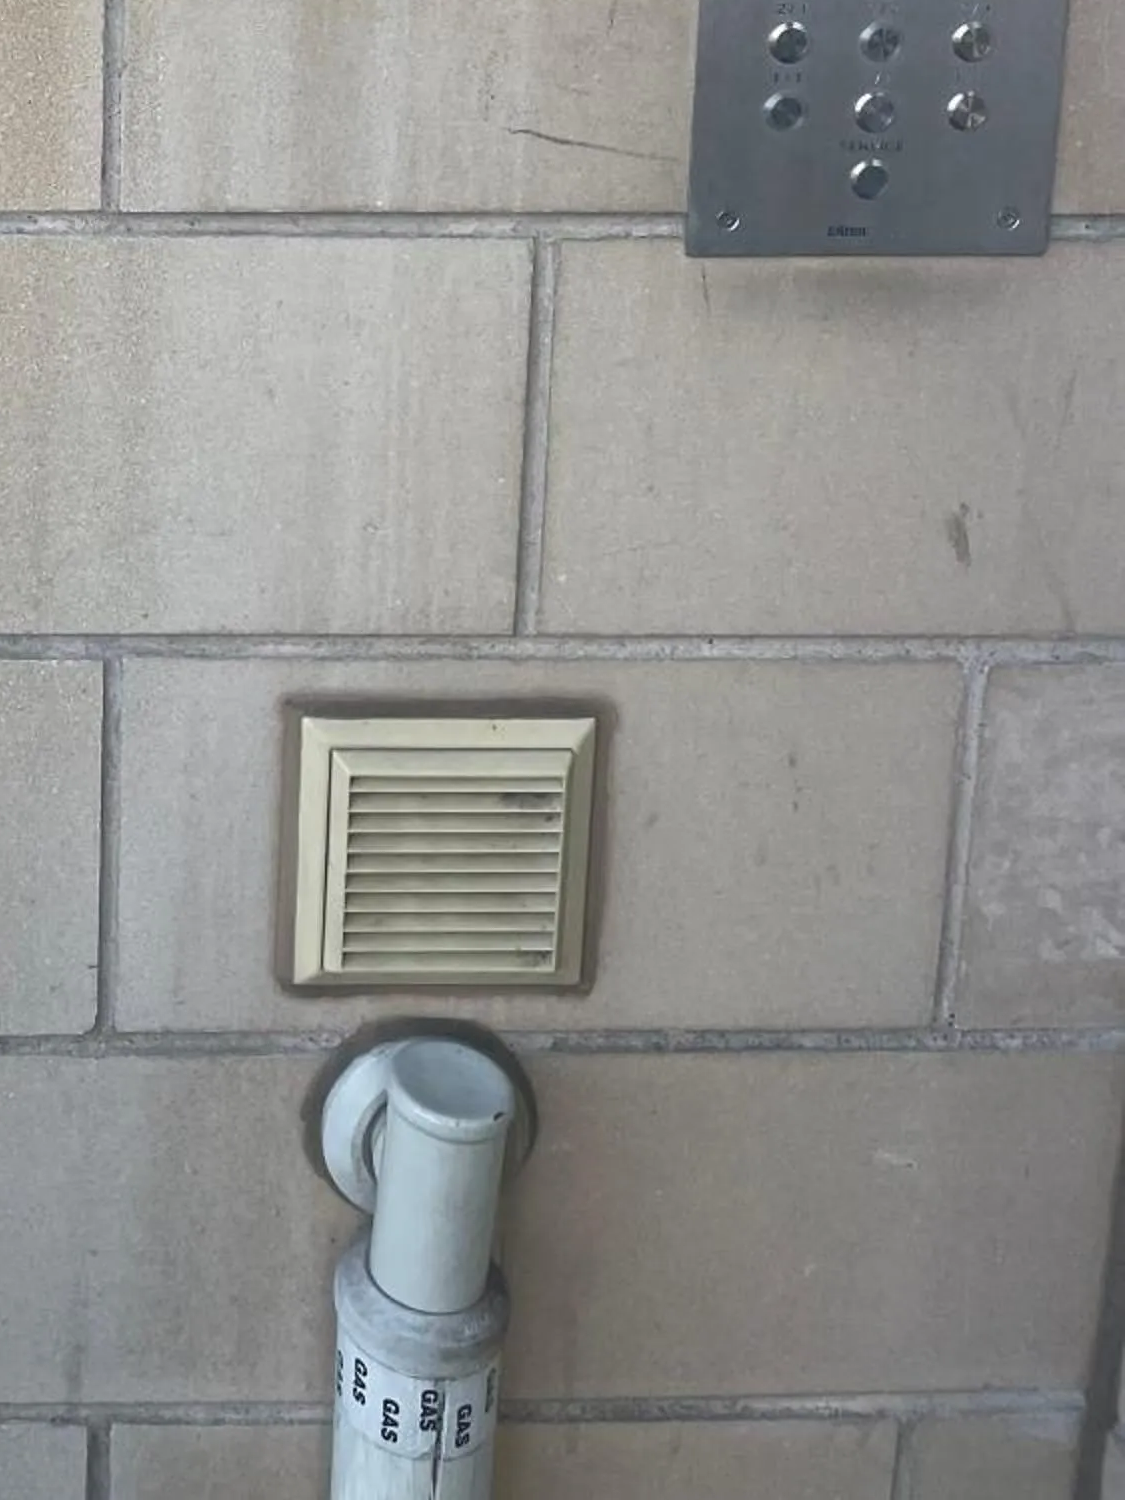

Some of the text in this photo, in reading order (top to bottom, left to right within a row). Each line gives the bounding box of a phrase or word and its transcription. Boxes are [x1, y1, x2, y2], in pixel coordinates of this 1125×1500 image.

[352, 1358, 368, 1406] GAS
[381, 1398, 400, 1444] GAS
[419, 1389, 438, 1432] GAS
[455, 1404, 472, 1449] GAS
